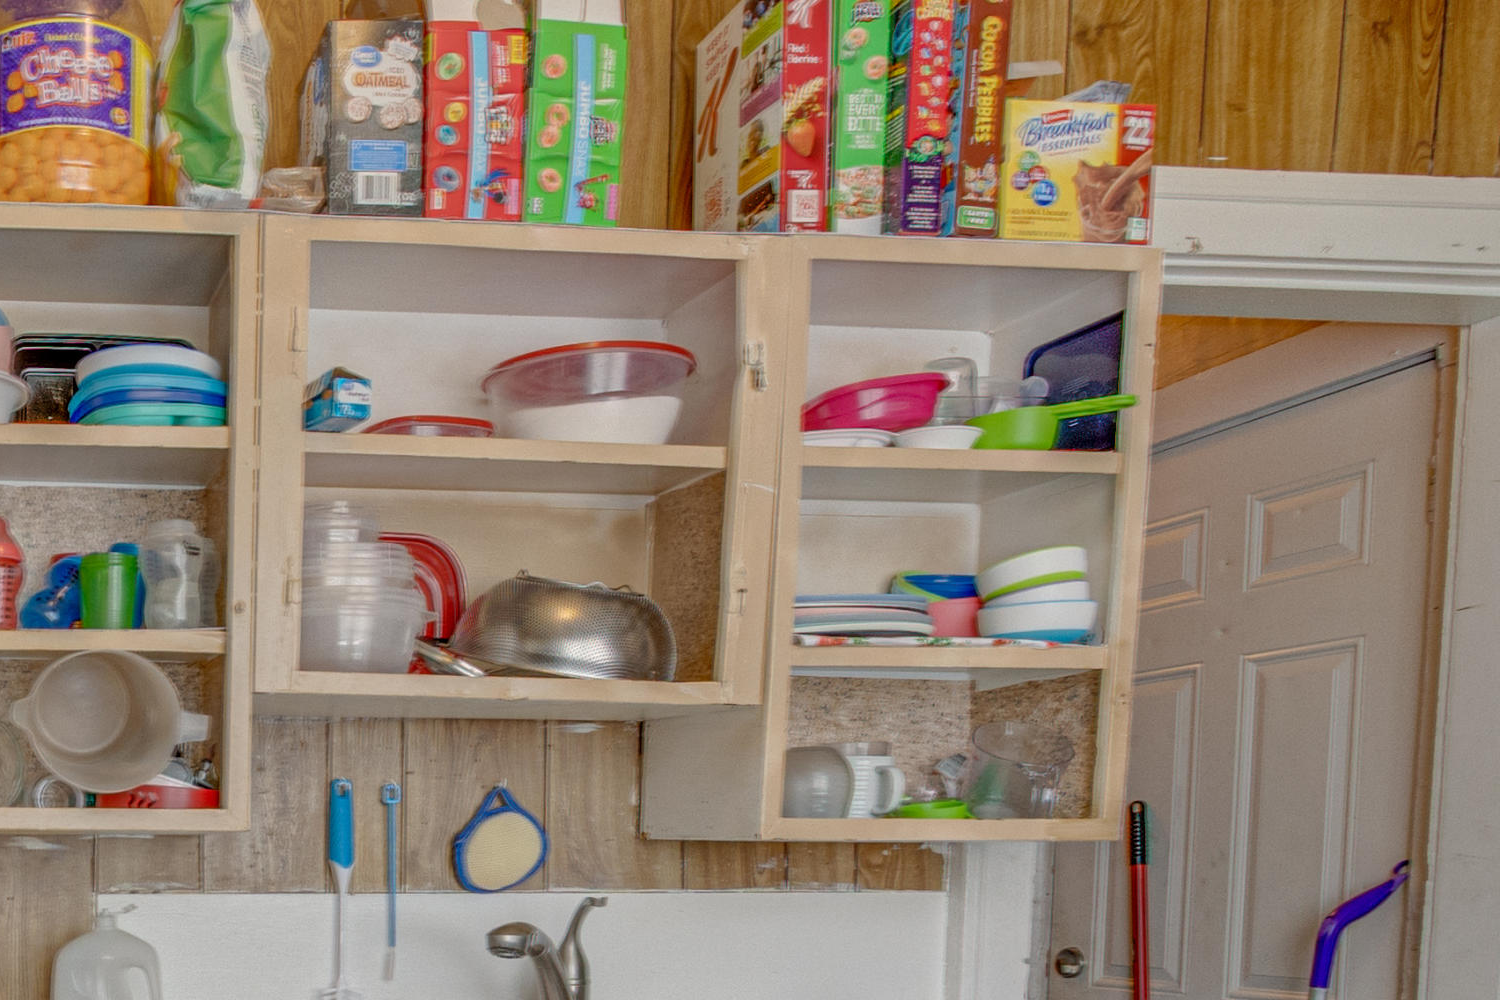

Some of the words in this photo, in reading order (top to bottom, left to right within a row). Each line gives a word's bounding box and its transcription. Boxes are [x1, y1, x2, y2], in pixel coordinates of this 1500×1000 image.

[980, 16, 1002, 72] COCOA
[22, 47, 114, 81] Cheese
[351, 71, 412, 90] OATMEAL
[38, 78, 102, 104] Balls
[975, 75, 1001, 142] PEBBLES
[1016, 112, 1116, 147] Breakfast
